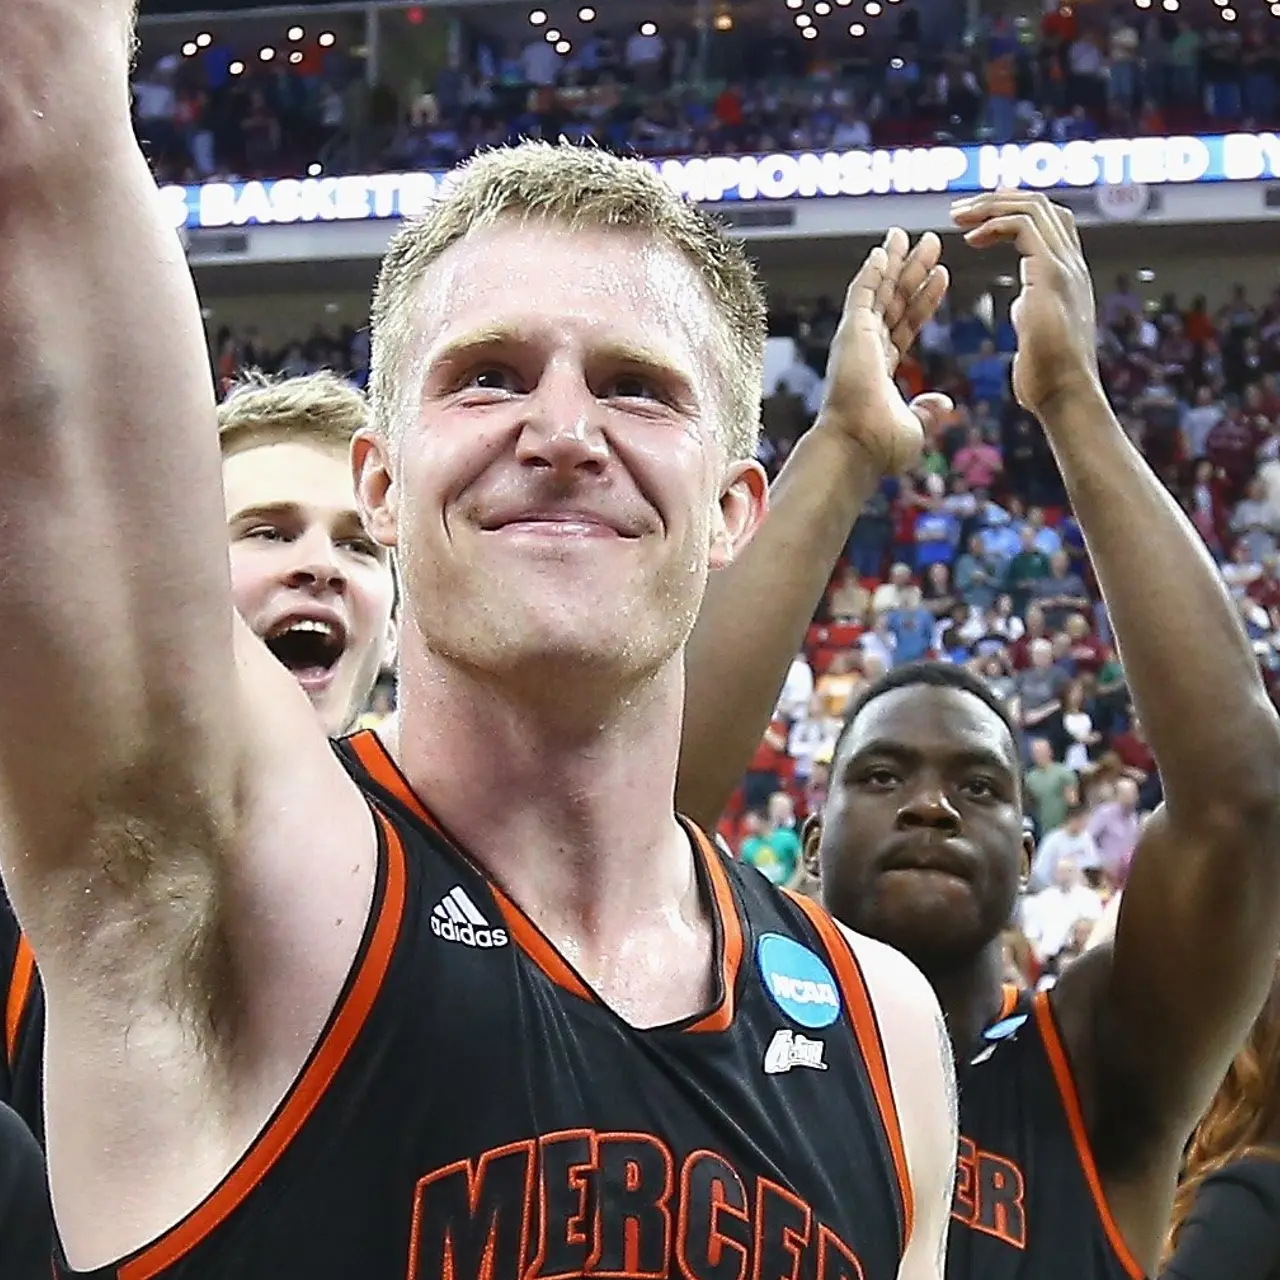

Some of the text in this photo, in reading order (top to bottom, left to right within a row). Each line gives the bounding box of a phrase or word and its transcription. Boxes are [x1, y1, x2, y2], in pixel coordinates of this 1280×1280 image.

[979, 137, 1210, 189] HOSTED
[430, 915, 508, 950] adidas
[770, 972, 838, 1007] NCAA
